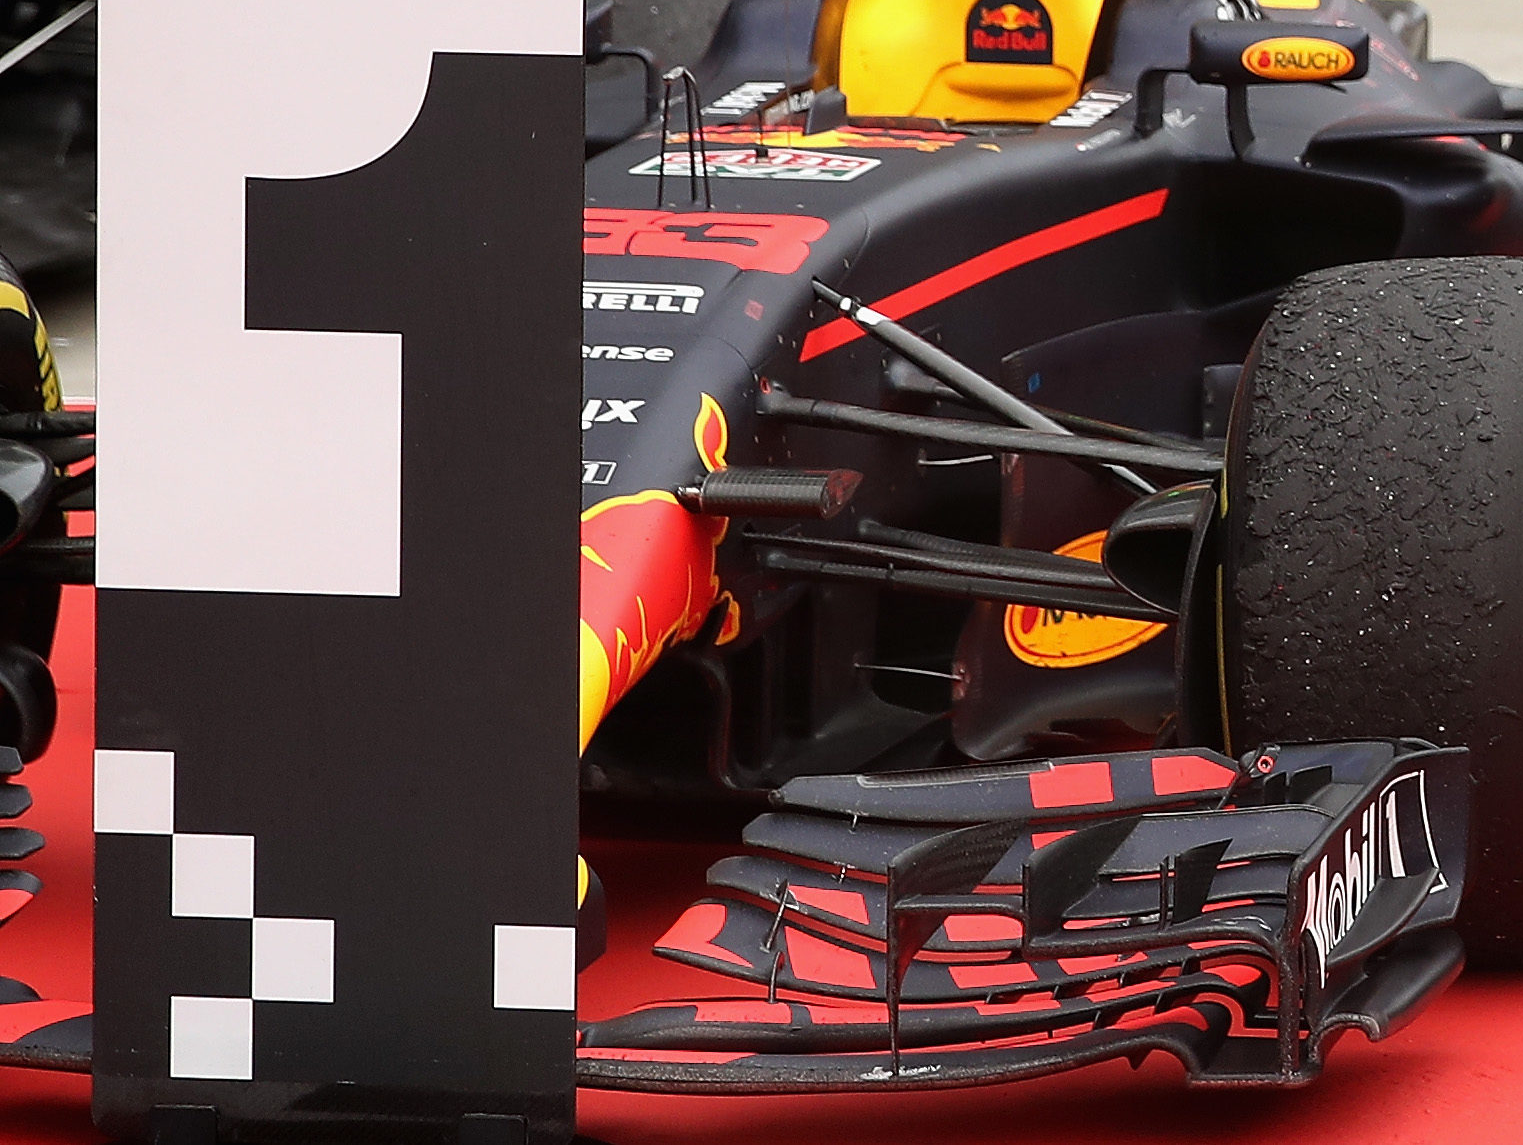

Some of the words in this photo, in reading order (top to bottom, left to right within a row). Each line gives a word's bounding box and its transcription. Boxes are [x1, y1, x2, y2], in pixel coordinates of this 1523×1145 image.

[972, 29, 1010, 51] Red
[1011, 29, 1048, 52] Bull
[1273, 51, 1339, 71] RAUCH
[243, 52, 585, 645] 1
[583, 344, 675, 363] ense
